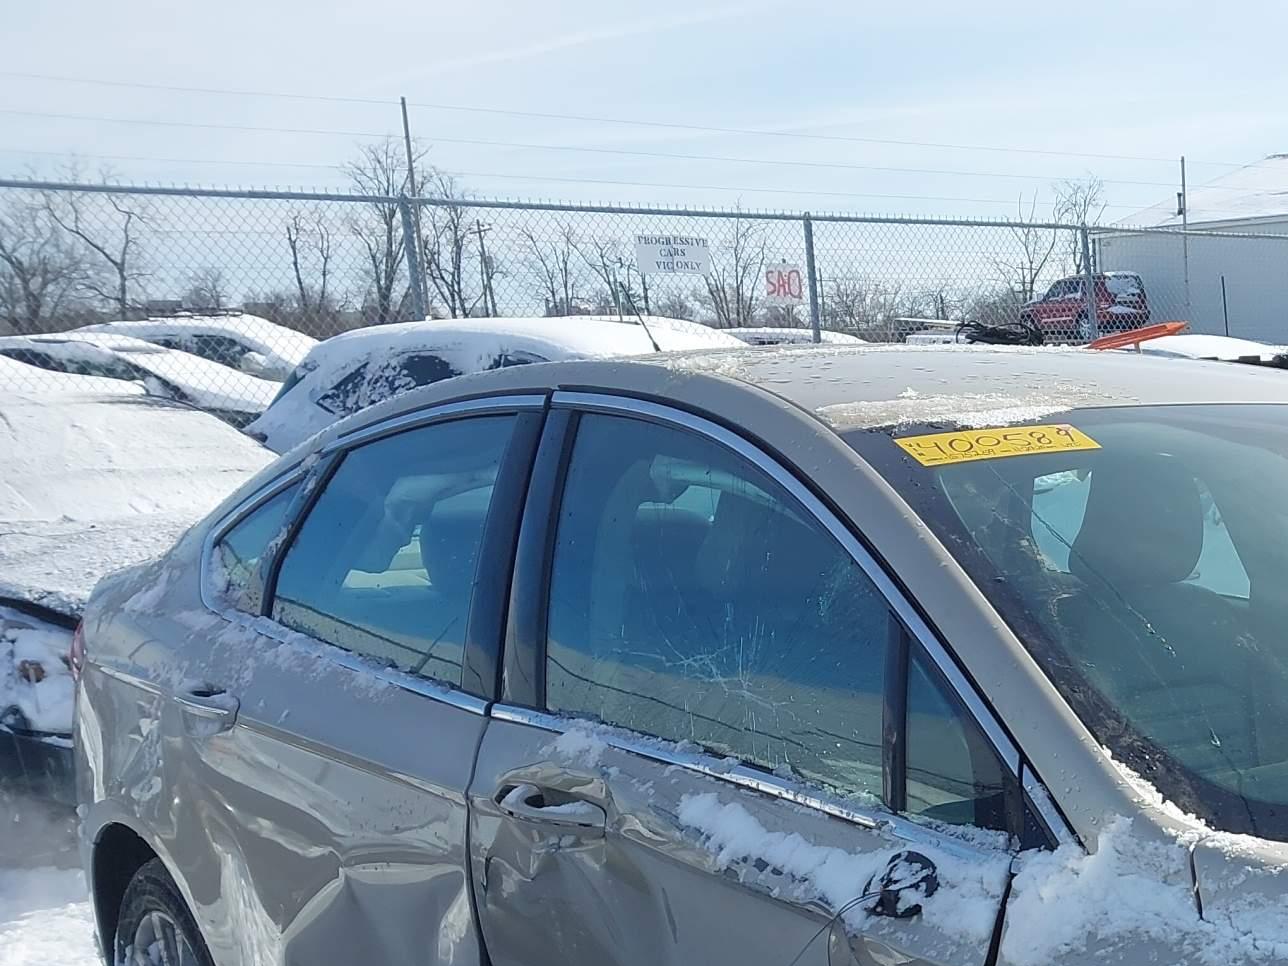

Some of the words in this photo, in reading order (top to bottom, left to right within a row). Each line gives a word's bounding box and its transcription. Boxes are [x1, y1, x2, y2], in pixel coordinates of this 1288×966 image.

[637, 235, 708, 248] PROGRESSIVE
[659, 247, 686, 257] CARS
[655, 260, 673, 271] VIC
[676, 260, 702, 271] ONLY
[916, 427, 1075, 457] 400589
